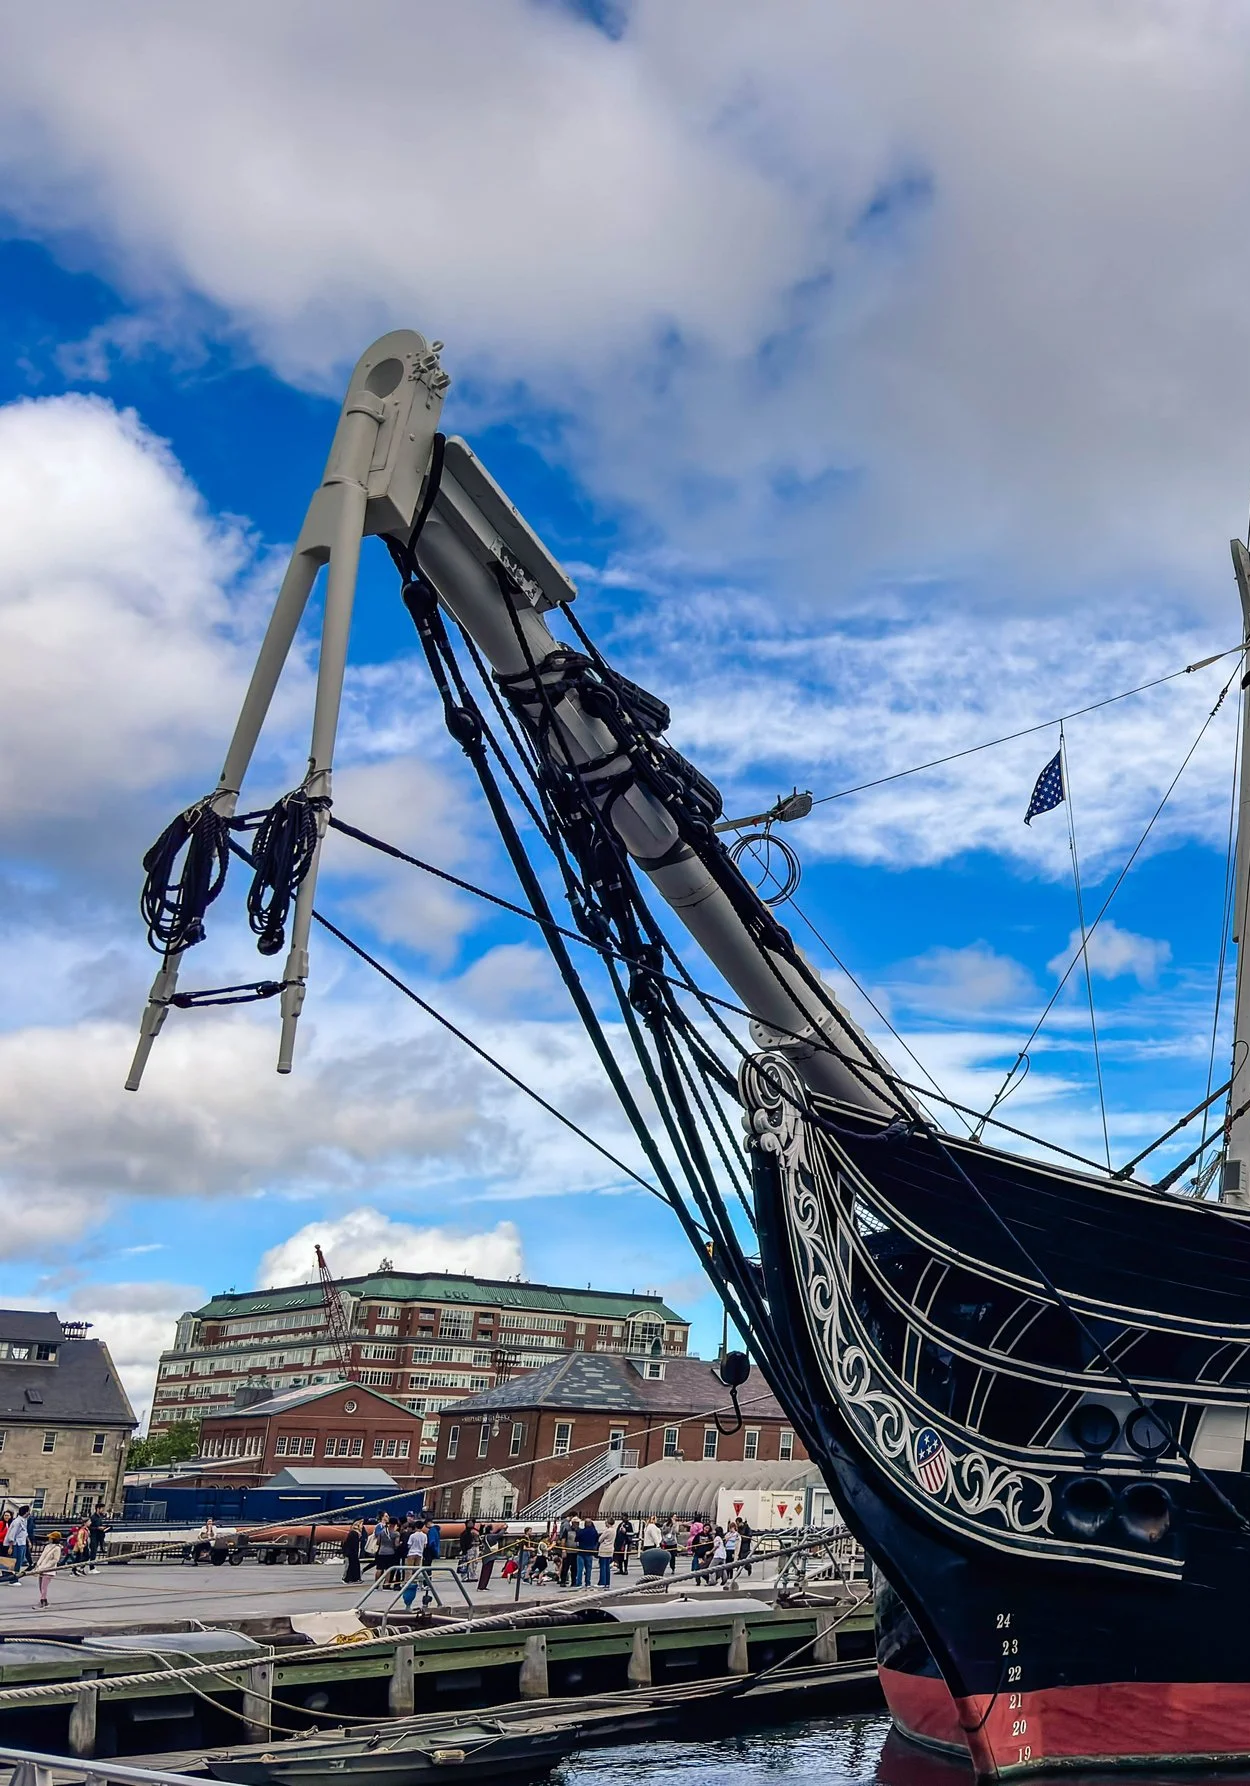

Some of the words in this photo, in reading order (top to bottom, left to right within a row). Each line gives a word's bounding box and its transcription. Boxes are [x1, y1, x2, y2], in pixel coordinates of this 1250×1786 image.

[996, 1613, 1011, 1629] 24
[1002, 1639, 1018, 1656] 23
[1008, 1665, 1022, 1683] 22
[1009, 1693, 1022, 1710] 21
[1012, 1719, 1027, 1737] 20
[1017, 1746, 1031, 1764] 19
